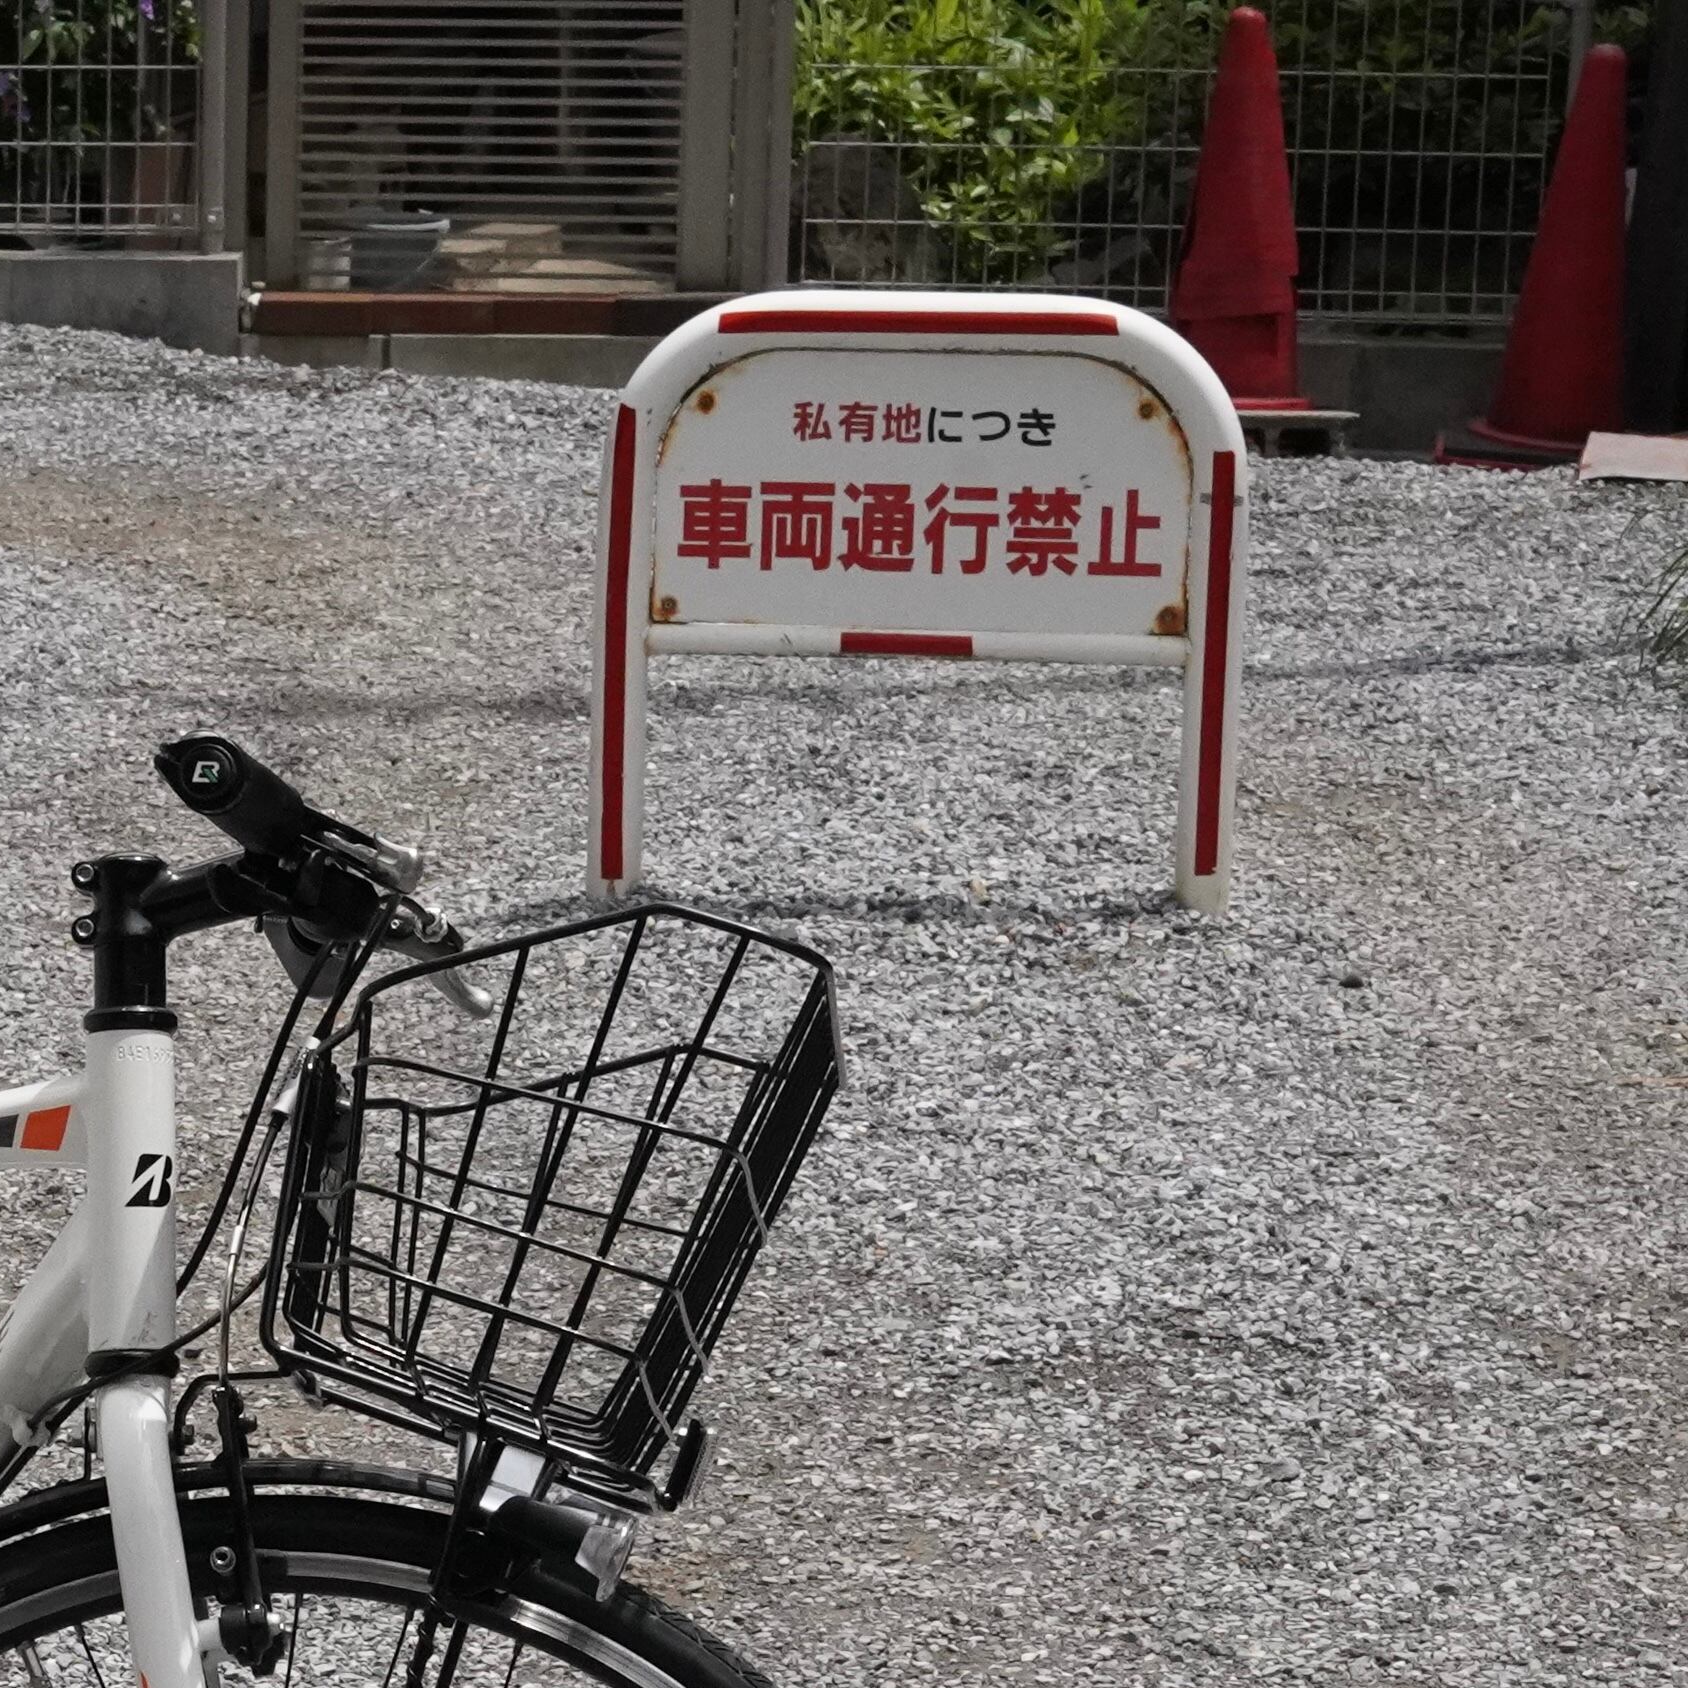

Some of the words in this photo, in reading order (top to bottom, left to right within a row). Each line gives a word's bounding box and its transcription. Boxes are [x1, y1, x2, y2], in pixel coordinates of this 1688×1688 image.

[793, 401, 1056, 447] 私有地につき
[677, 478, 1162, 577] 車両通行禁止
